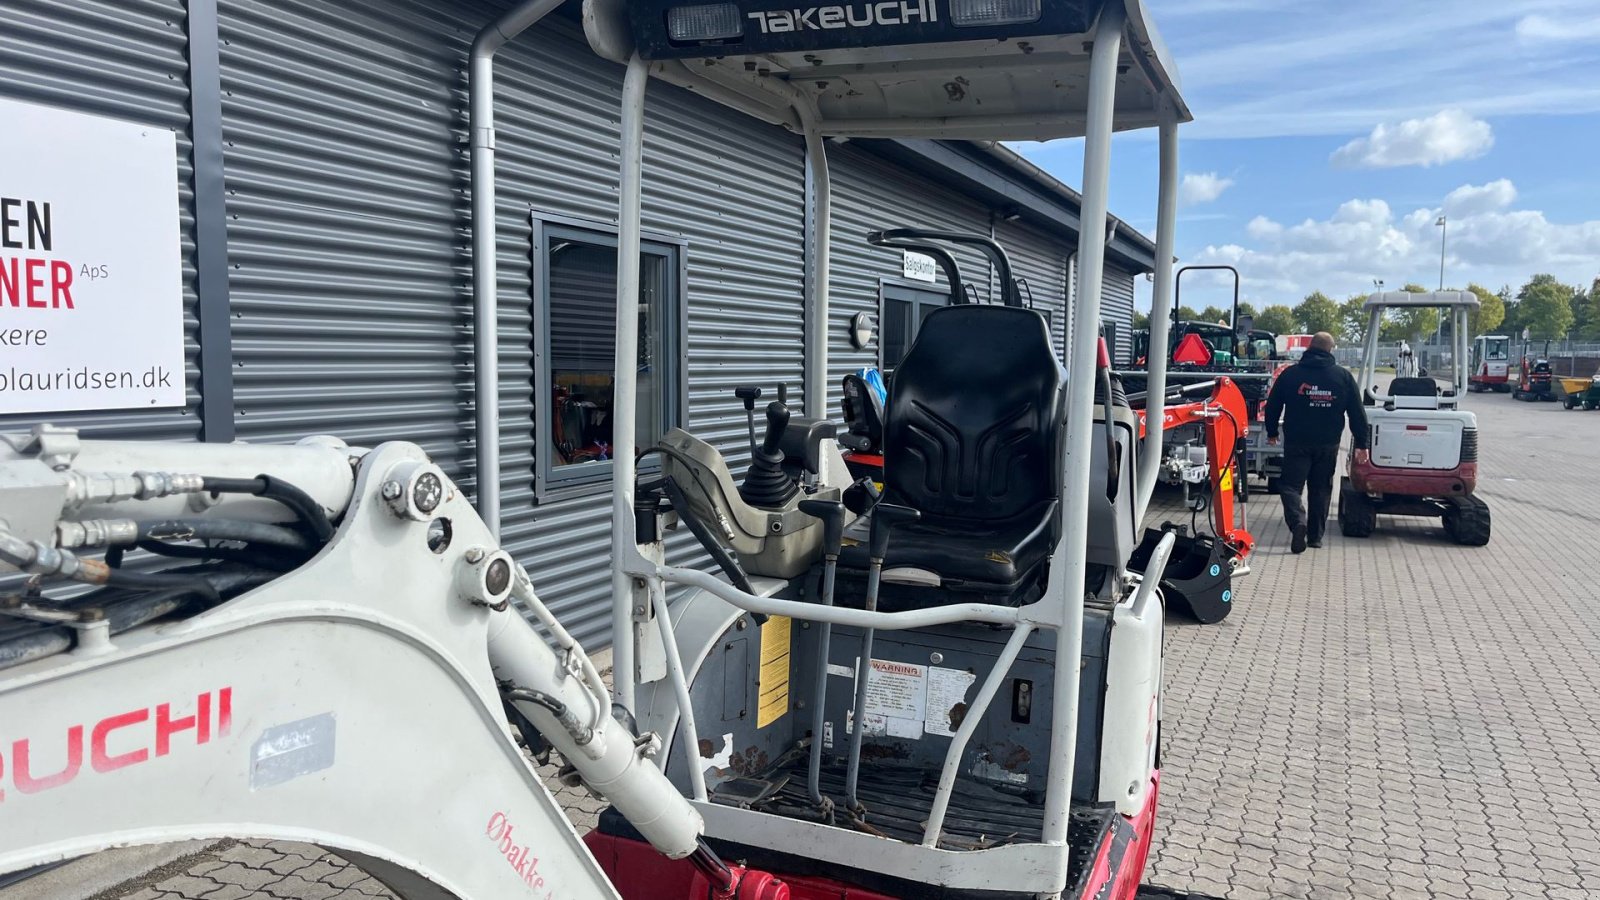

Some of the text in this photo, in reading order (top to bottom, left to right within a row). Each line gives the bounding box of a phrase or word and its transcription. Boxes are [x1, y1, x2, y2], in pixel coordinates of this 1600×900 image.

[1, 197, 52, 251] EN
[0, 257, 109, 309] NER ApS
[872, 662, 918, 675] WARNING
[0, 686, 232, 800] UCHI
